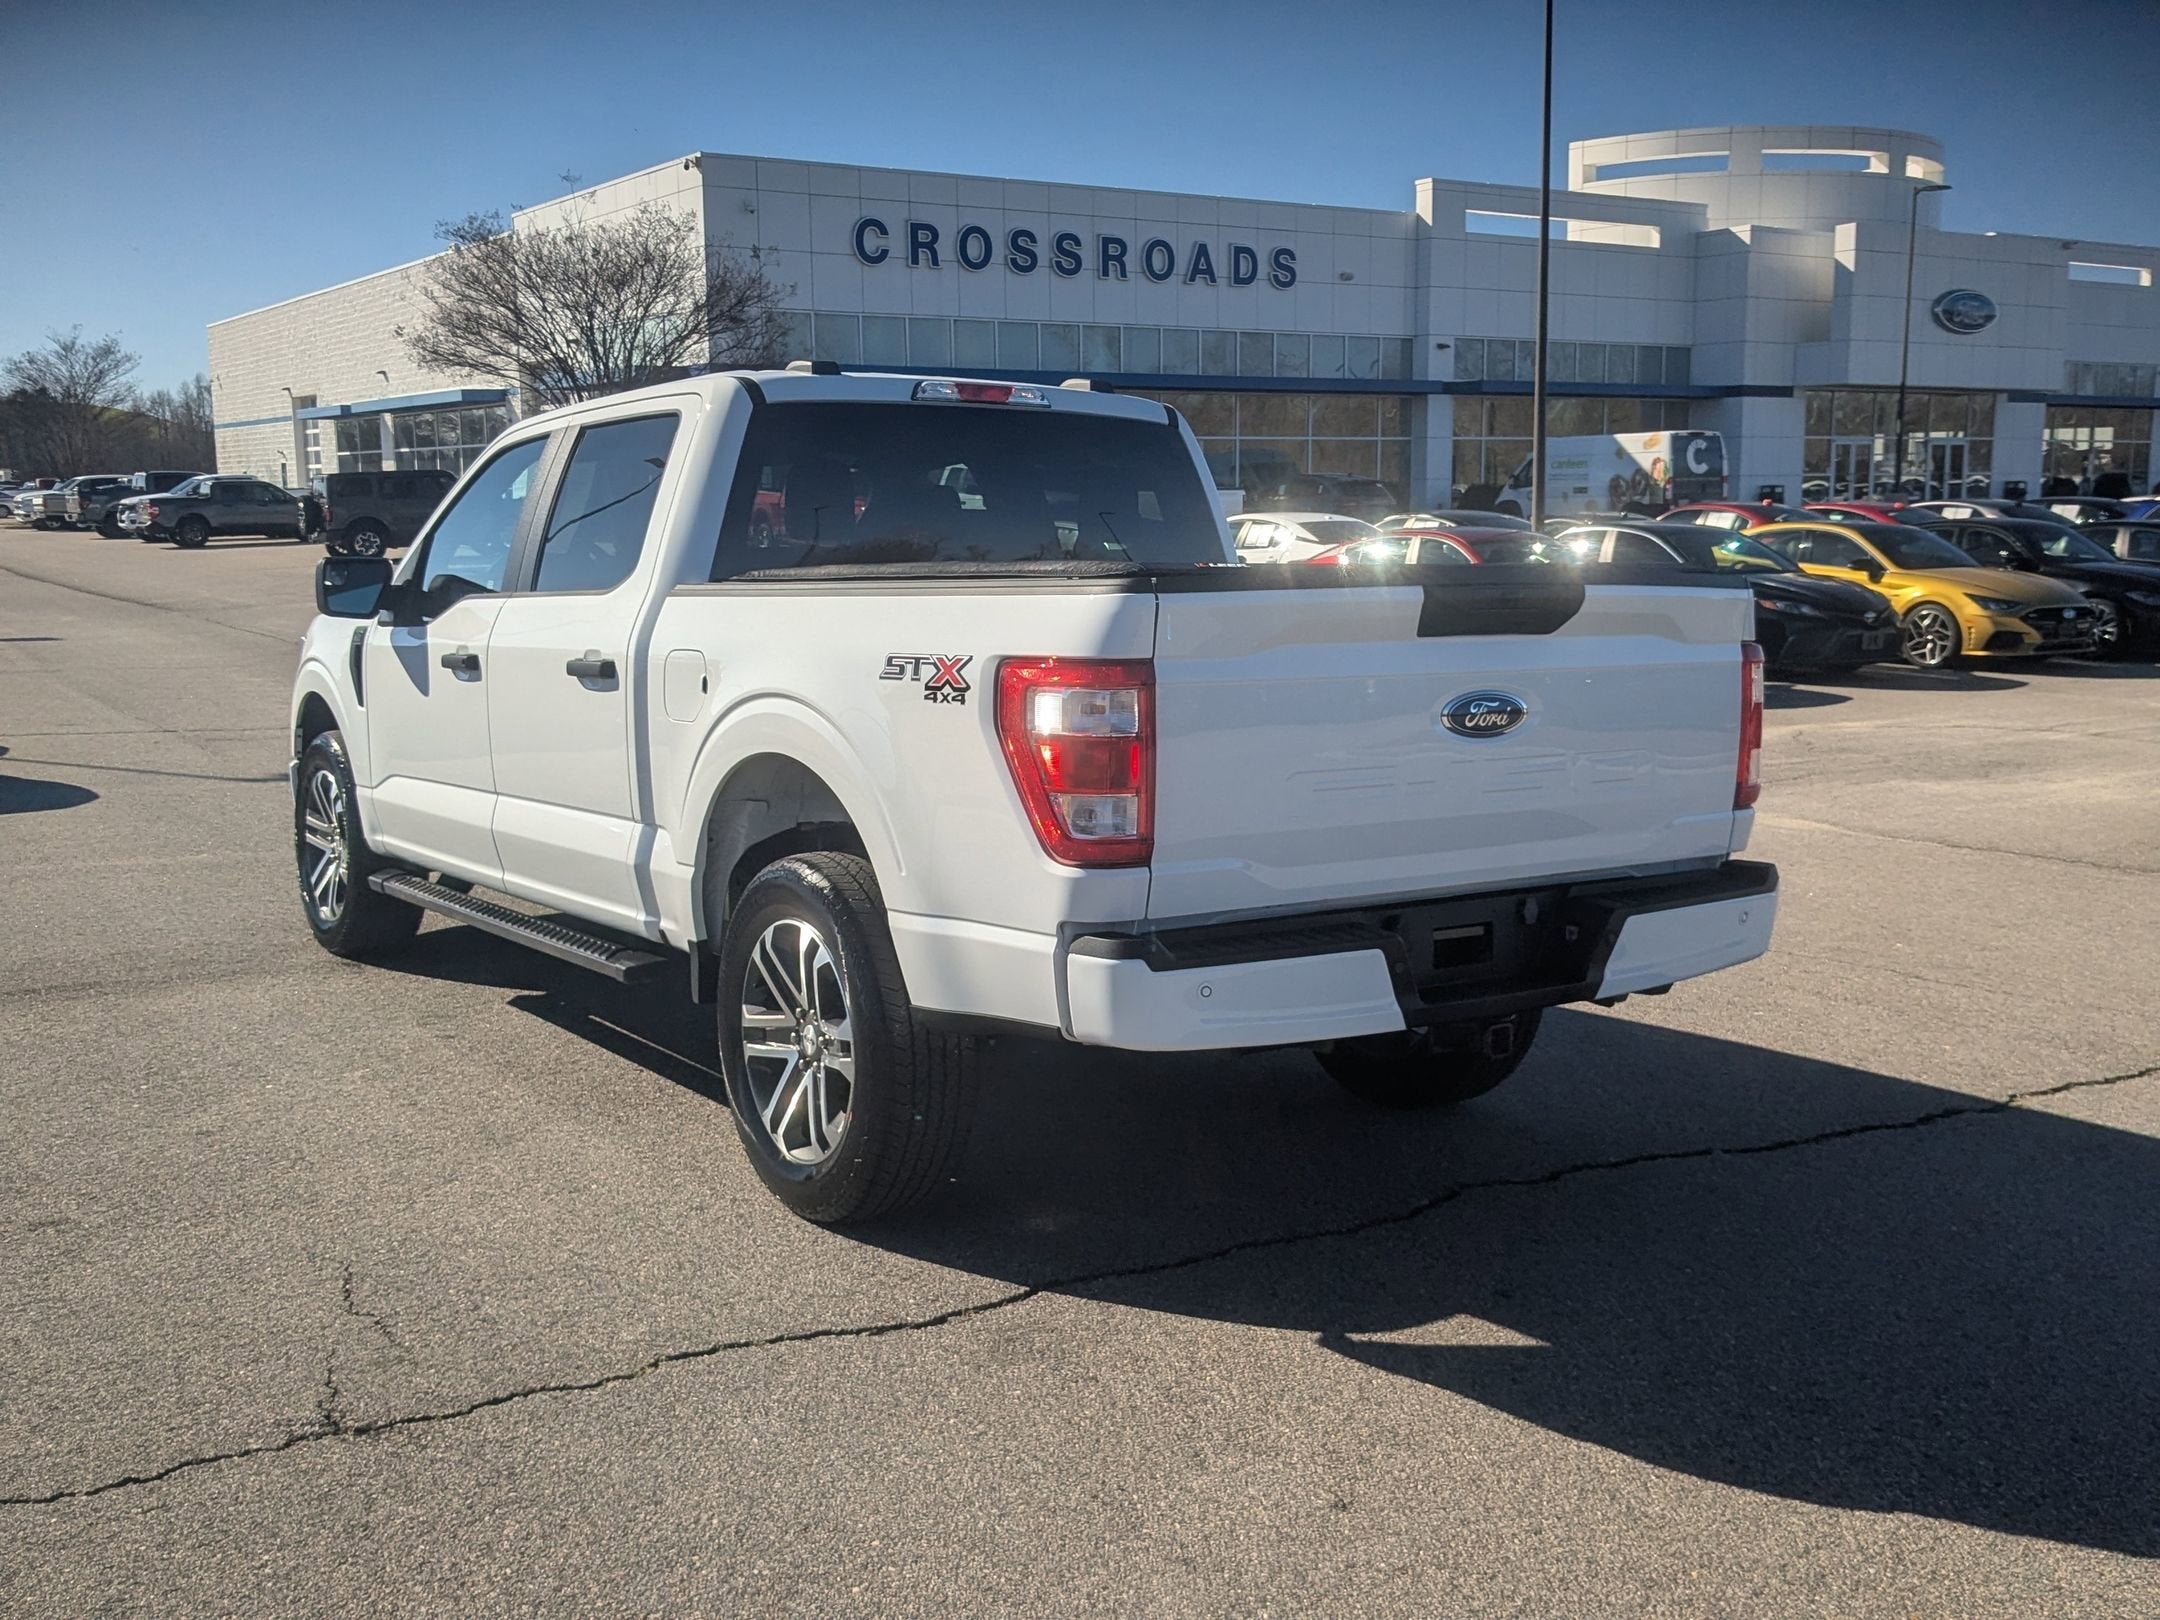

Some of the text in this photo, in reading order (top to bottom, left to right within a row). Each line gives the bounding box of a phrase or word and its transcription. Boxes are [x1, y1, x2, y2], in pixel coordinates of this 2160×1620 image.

[853, 217, 1298, 290] CROSSROADS
[1687, 439, 1709, 474] C
[879, 653, 973, 692] STX
[1465, 701, 1511, 727] Ford
